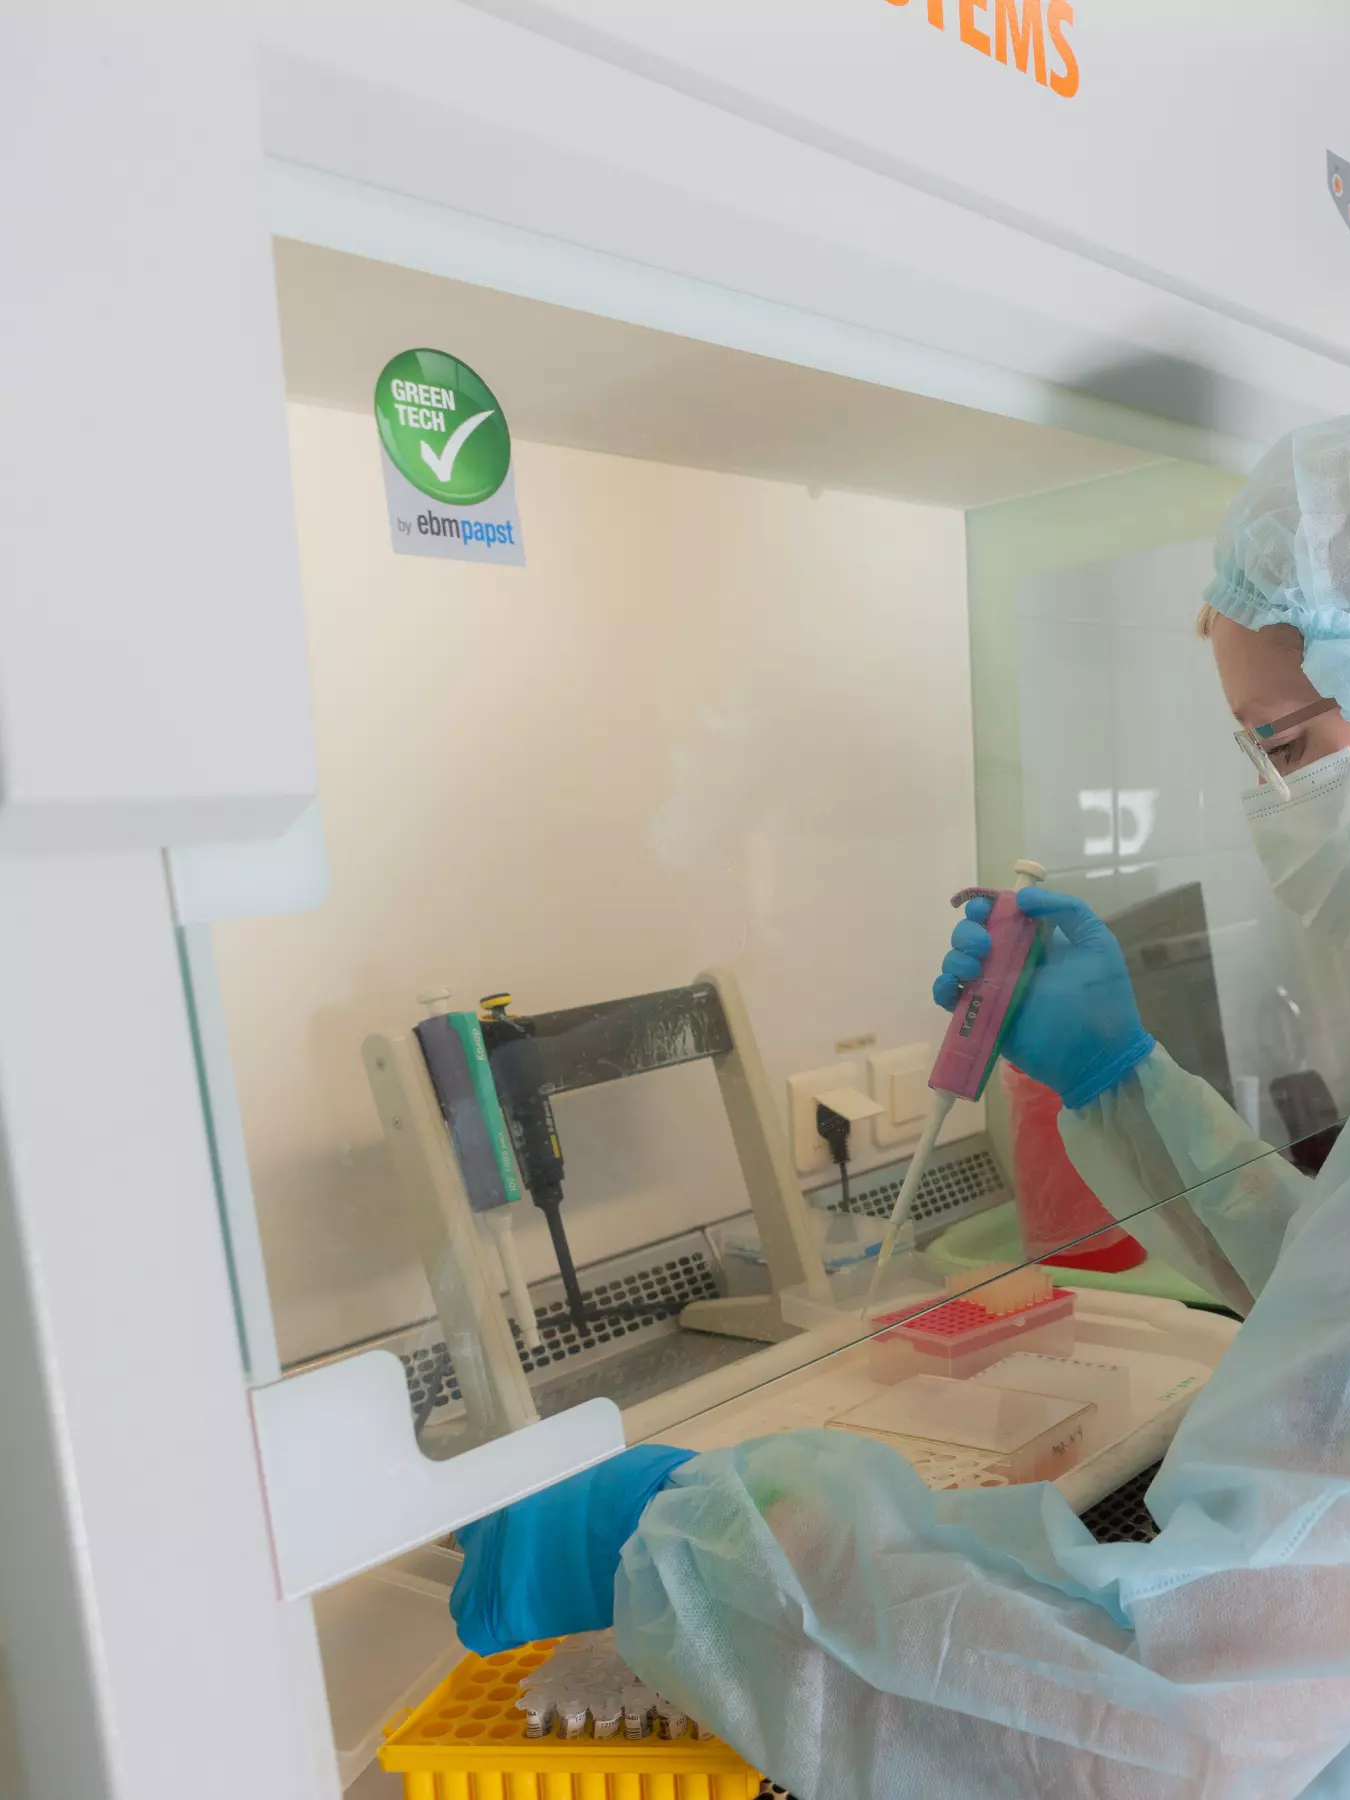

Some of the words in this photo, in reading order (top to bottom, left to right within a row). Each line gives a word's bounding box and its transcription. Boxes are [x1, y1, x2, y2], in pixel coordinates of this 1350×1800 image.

[884, 0, 1079, 98] EMS
[391, 379, 456, 411] GREEN
[395, 404, 446, 432] TECH
[397, 517, 412, 535] by
[417, 510, 516, 547] ebmpapst
